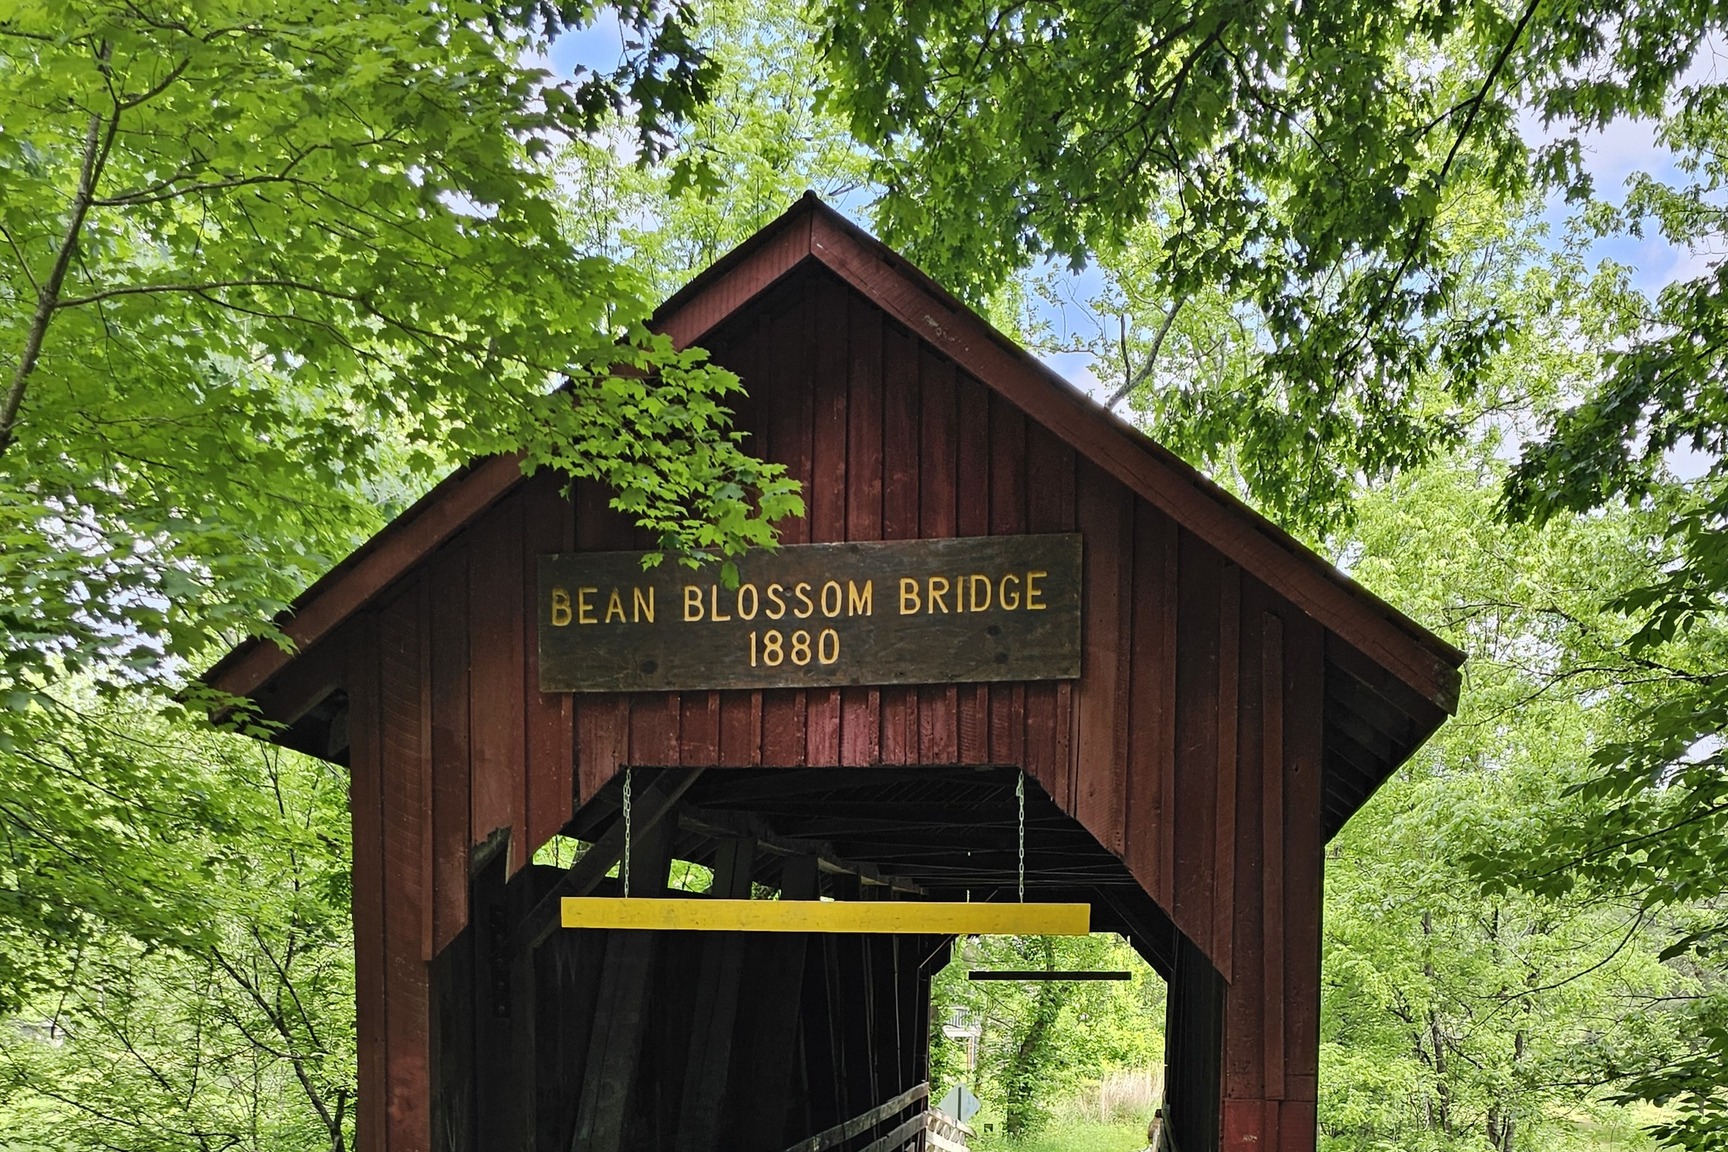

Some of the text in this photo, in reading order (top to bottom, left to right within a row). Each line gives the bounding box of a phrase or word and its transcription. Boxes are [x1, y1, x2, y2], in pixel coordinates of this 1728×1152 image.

[551, 571, 1048, 626] BEAN BLOSSOM BRIDGE
[749, 628, 841, 667] 1880
